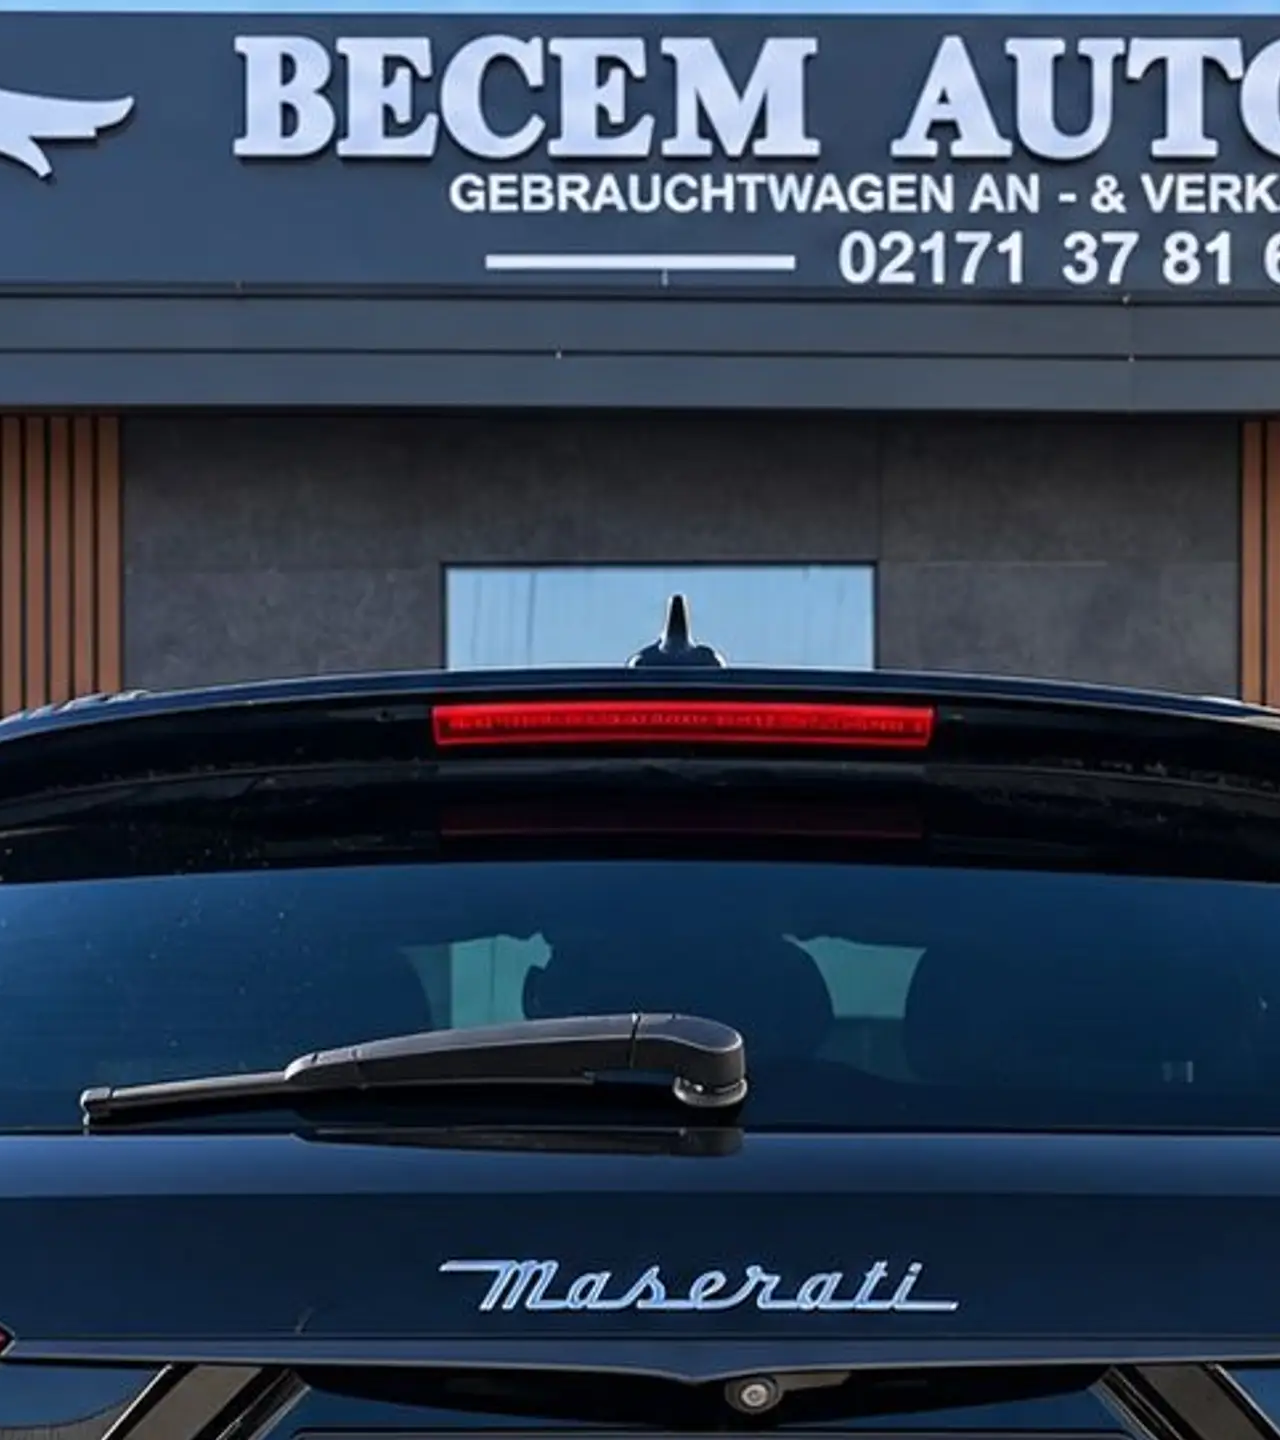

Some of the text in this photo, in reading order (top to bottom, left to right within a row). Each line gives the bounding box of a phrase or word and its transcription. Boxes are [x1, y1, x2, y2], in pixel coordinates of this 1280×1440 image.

[233, 35, 821, 159] BECEM
[449, 173, 954, 214] GEBRAUCHTWAGEN
[969, 173, 1039, 214] AN
[1091, 174, 1127, 214] &
[839, 231, 1022, 285] 02171
[1063, 231, 1139, 285] 37
[1163, 231, 1231, 285] 81
[439, 1259, 959, 1311] Maserati
